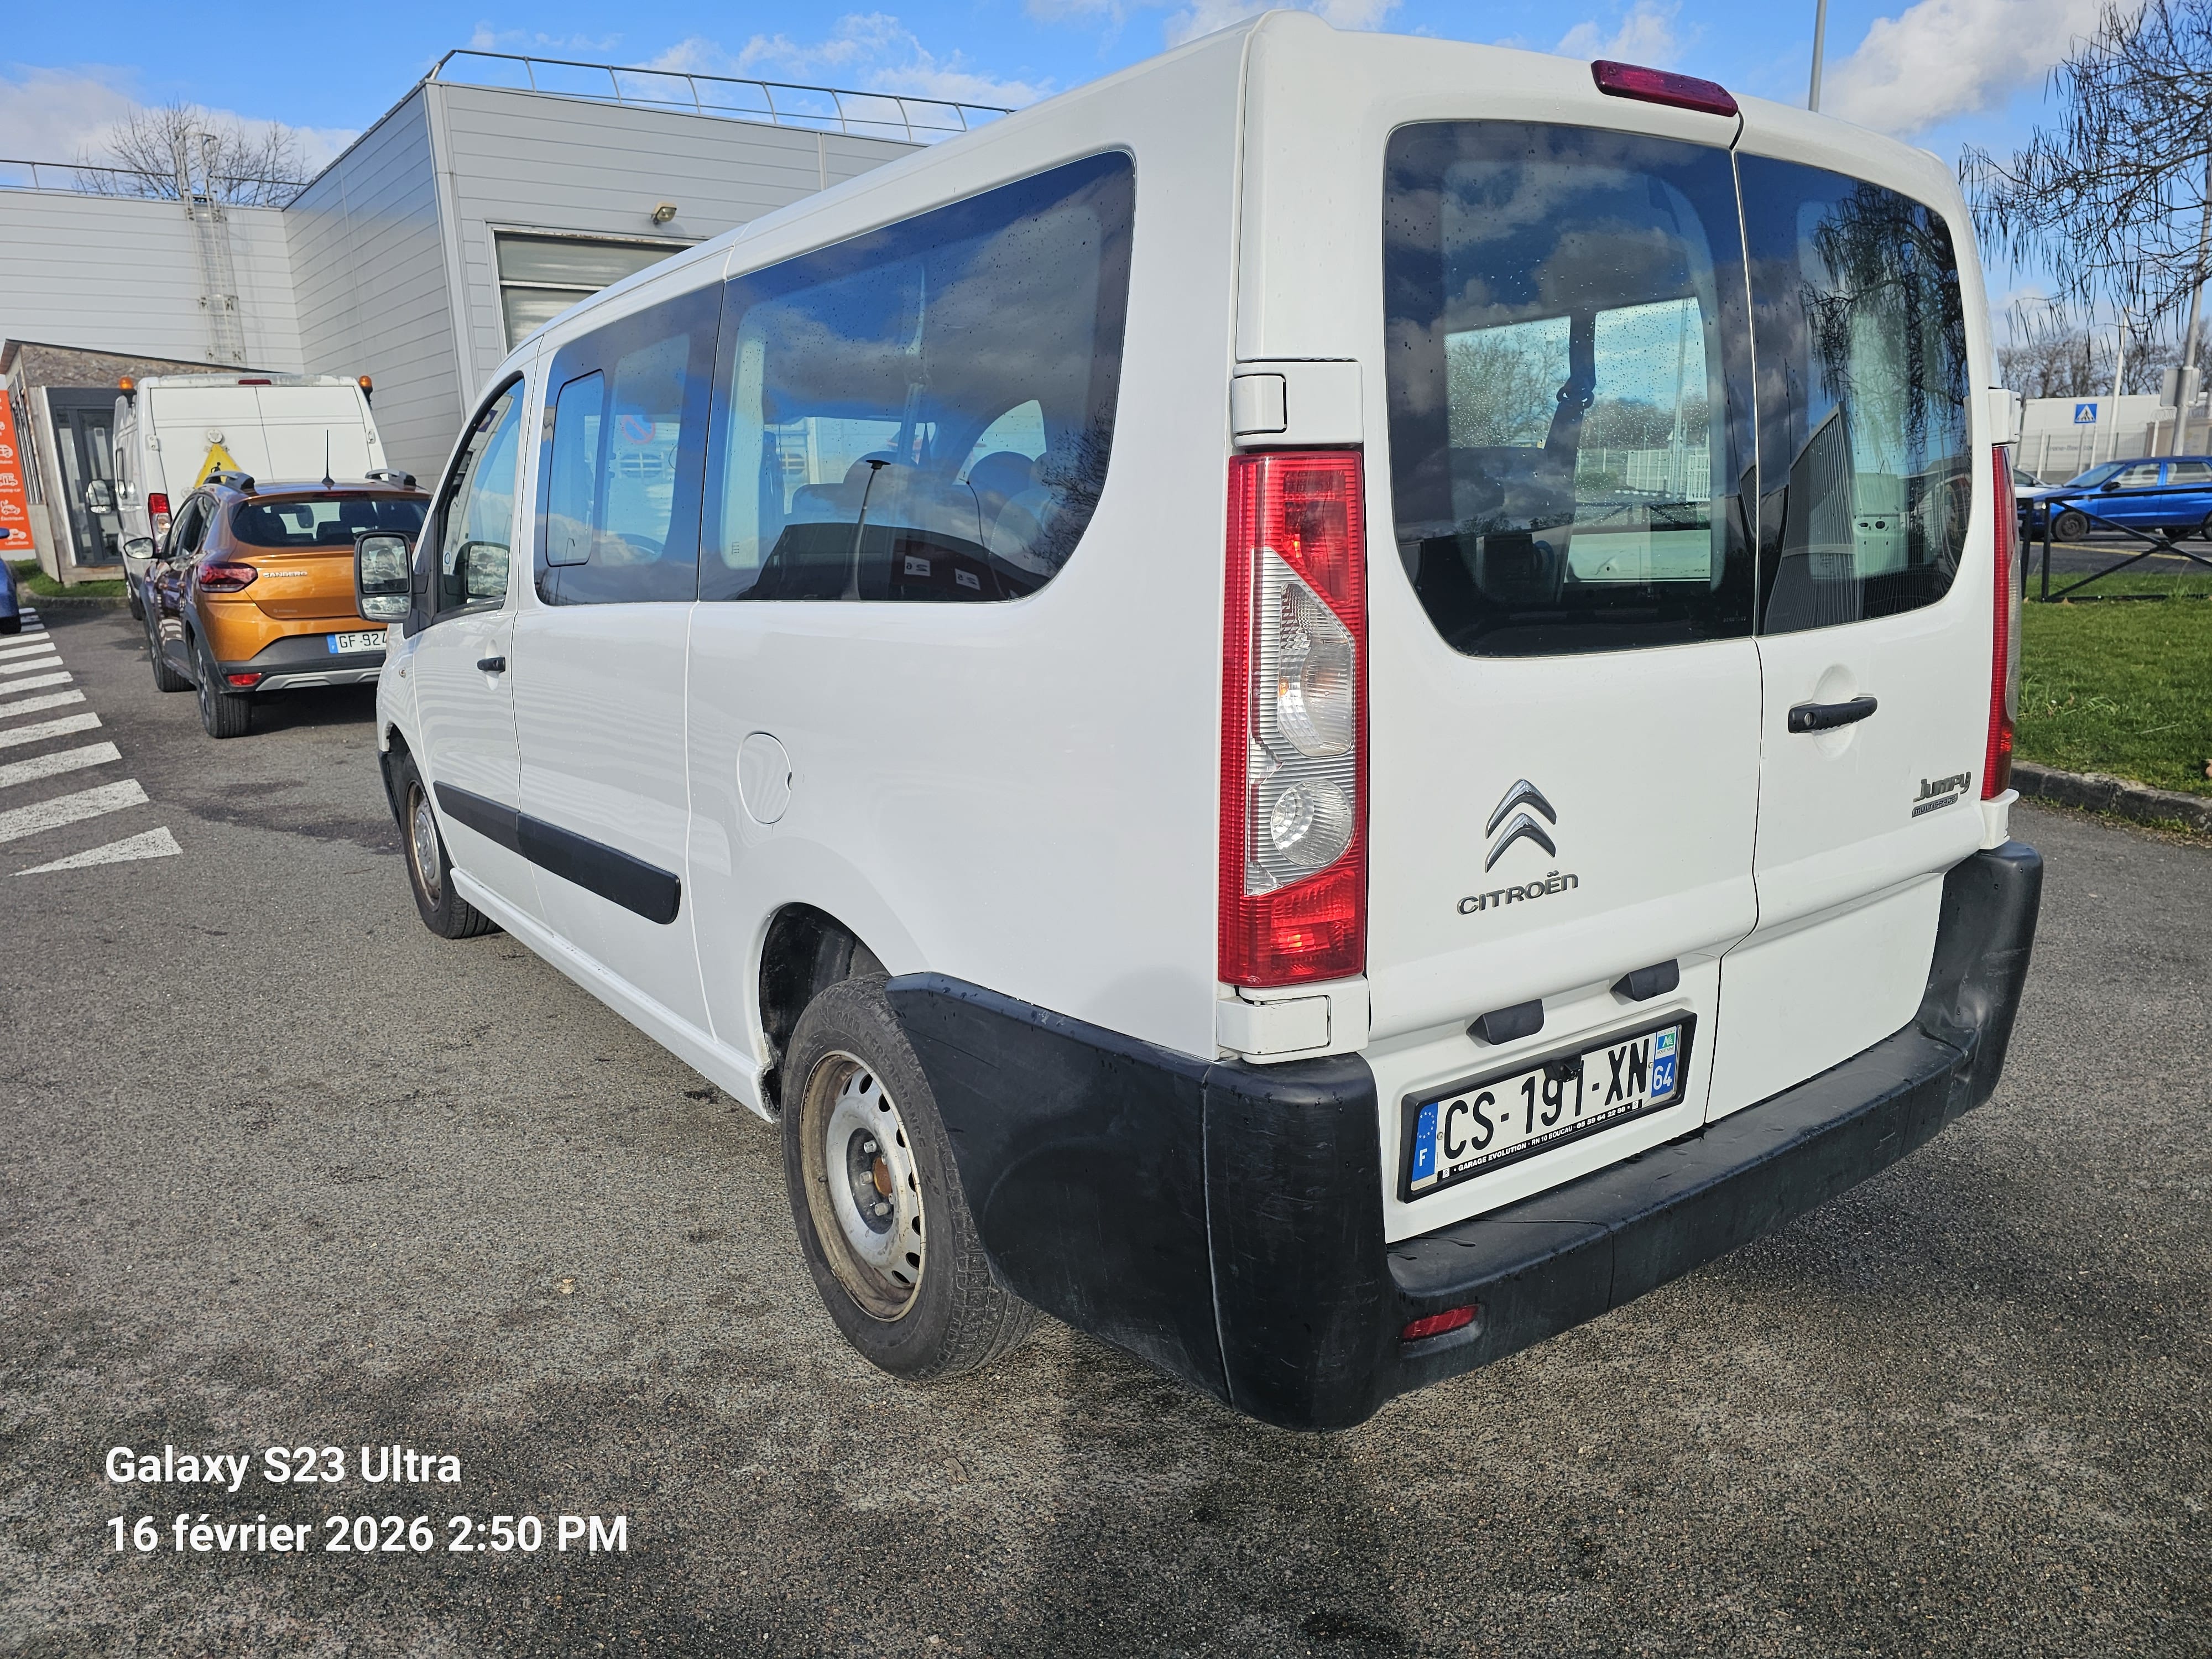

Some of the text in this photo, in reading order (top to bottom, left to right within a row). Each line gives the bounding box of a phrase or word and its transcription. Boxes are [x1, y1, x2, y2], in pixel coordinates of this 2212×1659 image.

[1913, 771, 1971, 802] Jumpy
[1913, 795, 1957, 816] MULTISPACE
[1457, 870, 1579, 915] CITROËN
[1656, 1046, 1674, 1055] AQUITAINE
[863, 1030, 926, 1148] PERFORMANCE
[1653, 1062, 1672, 1091] 64
[1444, 1038, 1650, 1160] CS-191-XN
[1419, 1148, 1428, 1167] F
[1458, 1156, 1487, 1172] GARAGE
[1488, 1142, 1527, 1161] EVOLUTION
[1531, 1137, 1540, 1146] RN
[1541, 1133, 1548, 1142] 10
[1548, 1125, 1573, 1140] BOUCAU
[1587, 1117, 1596, 1125] 59
